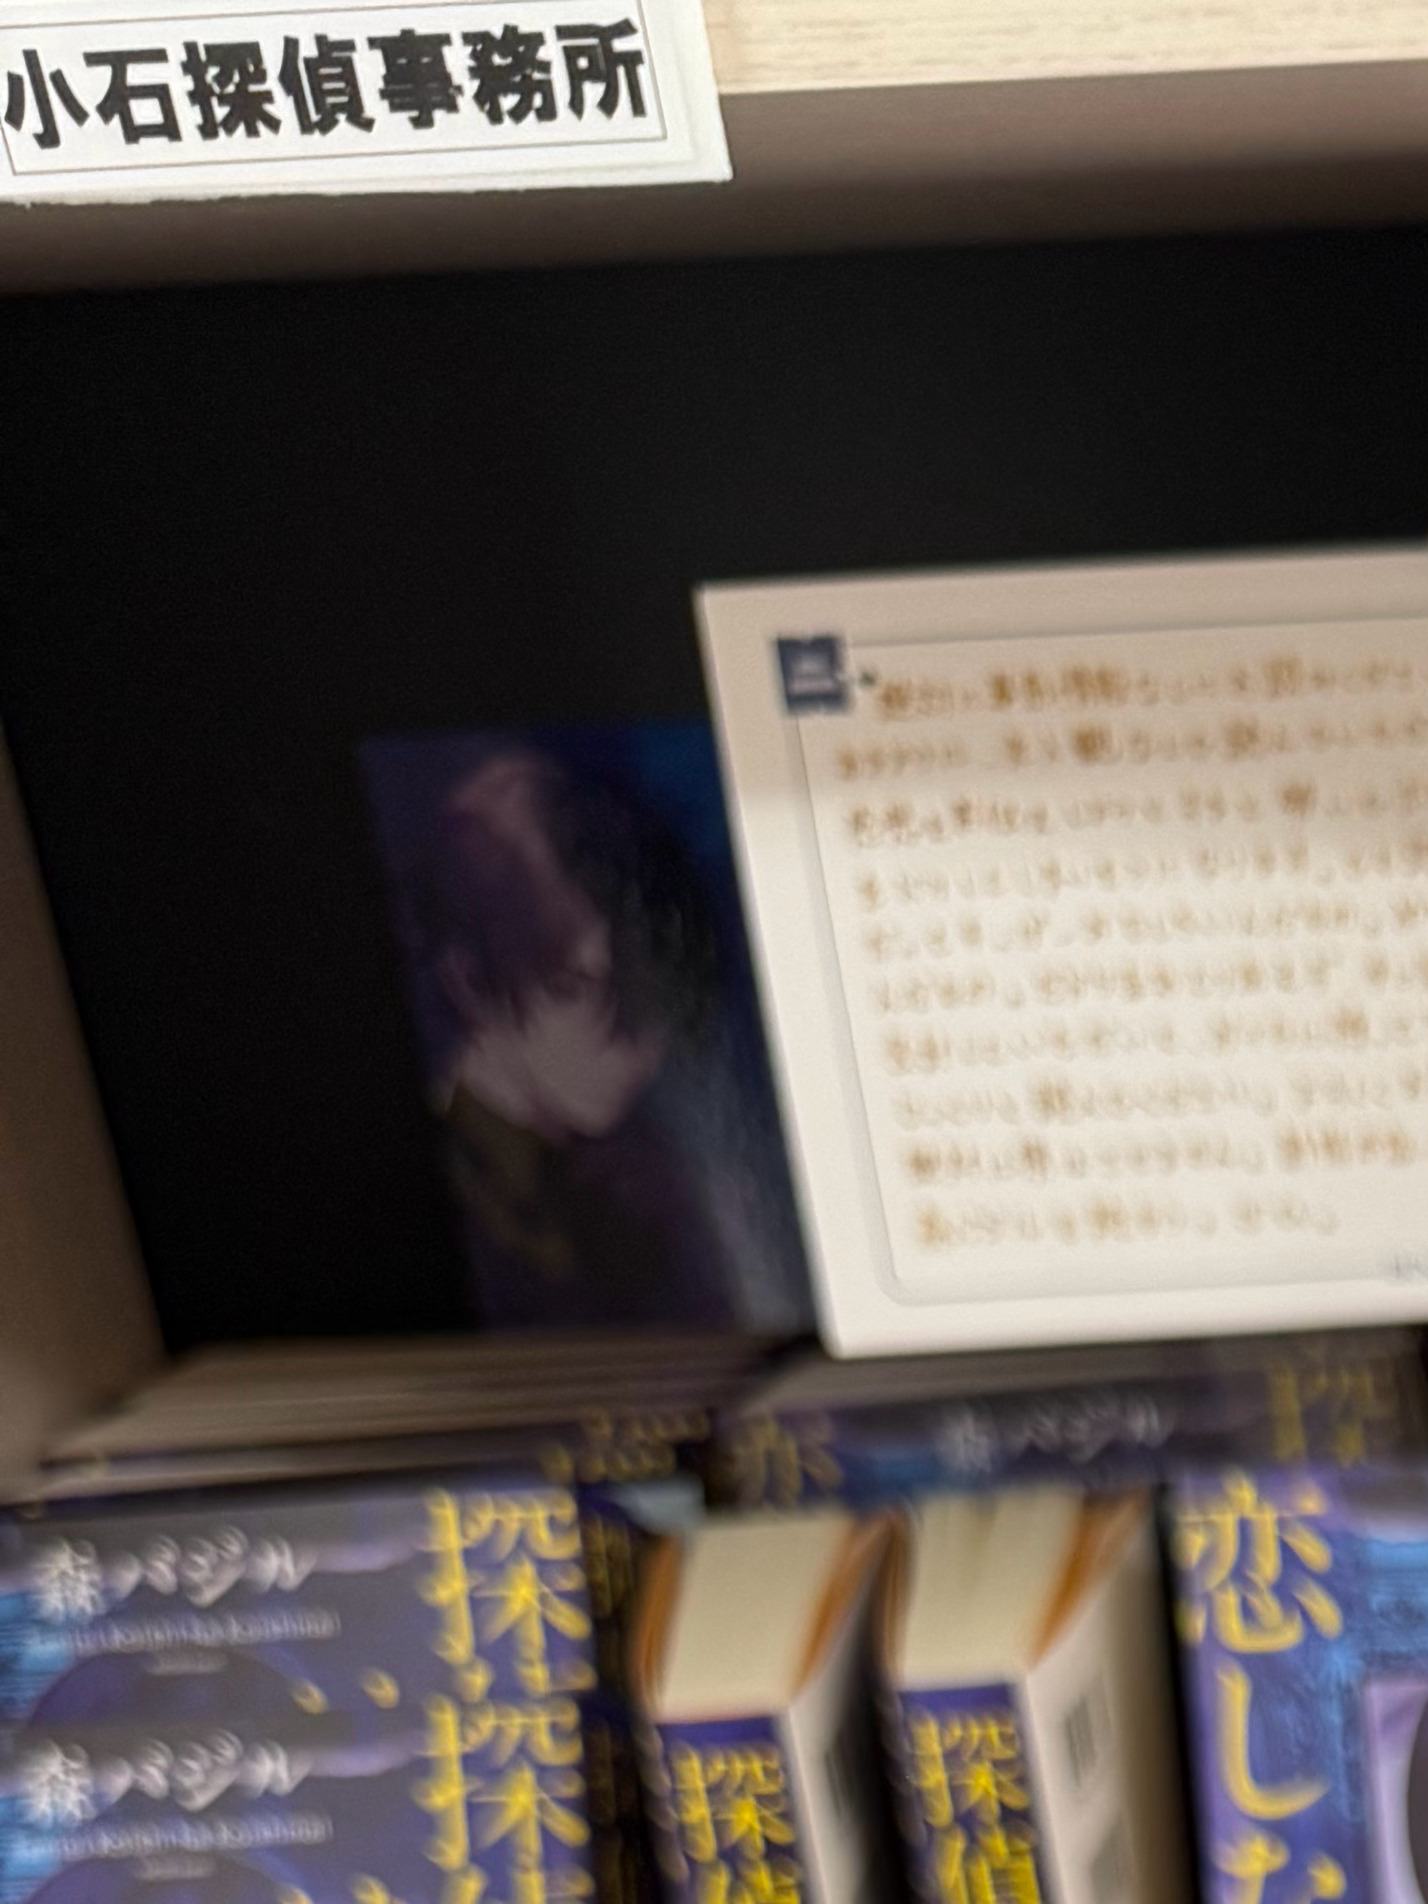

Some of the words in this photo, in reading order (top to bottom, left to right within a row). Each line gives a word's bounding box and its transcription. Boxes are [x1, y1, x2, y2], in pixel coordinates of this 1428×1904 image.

[3, 18, 649, 150] 小石探偵事務所
